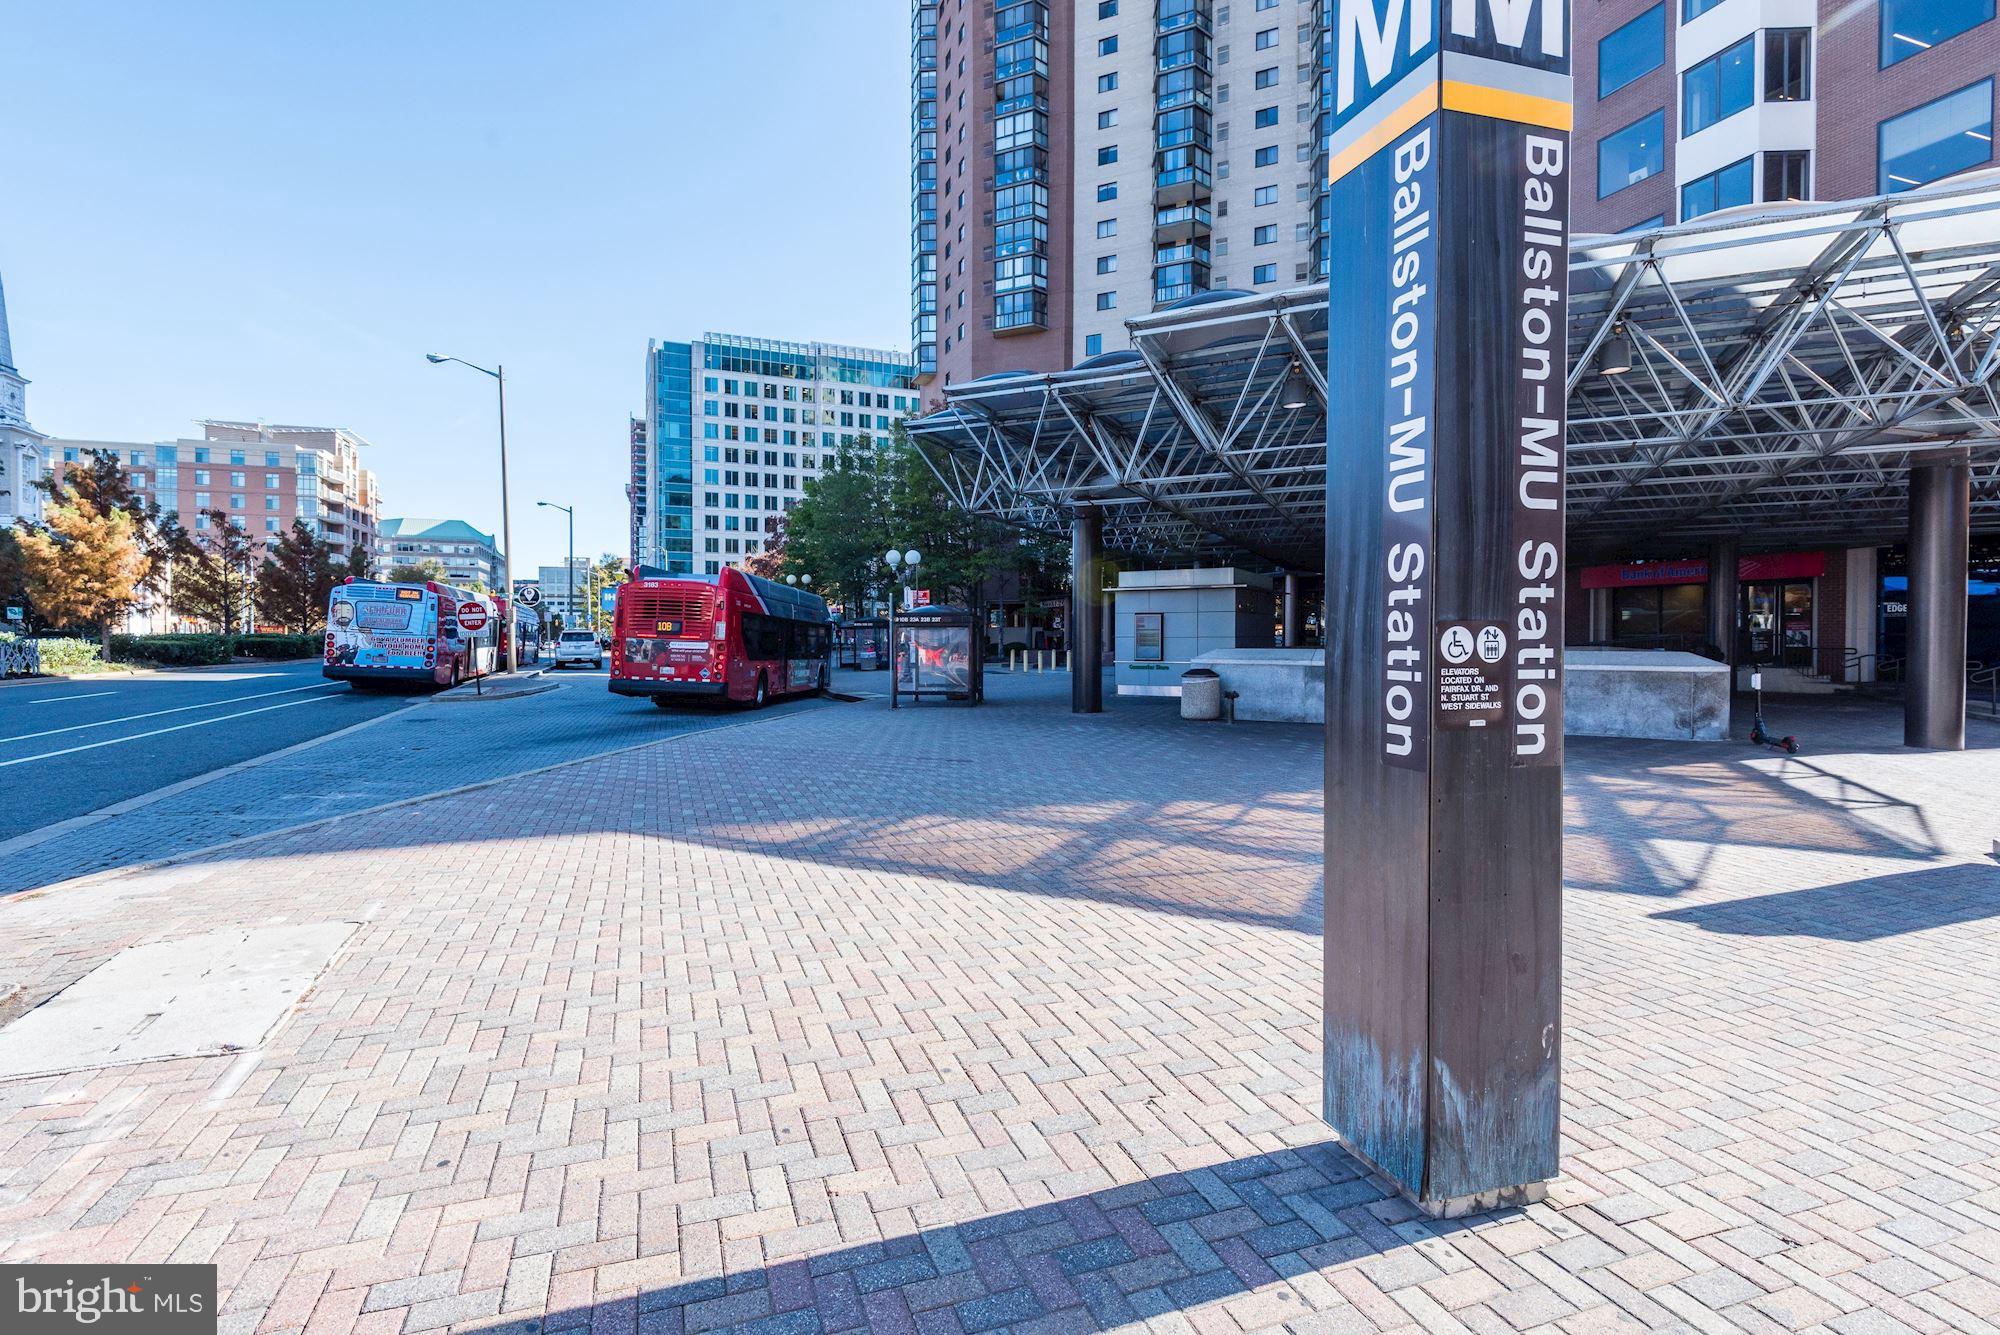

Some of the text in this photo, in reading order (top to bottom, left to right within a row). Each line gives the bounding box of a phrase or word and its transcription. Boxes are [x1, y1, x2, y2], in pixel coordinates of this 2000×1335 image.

[1620, 569, 1650, 580] Bank
[1886, 604, 1907, 613] EDGE
[657, 622, 672, 631] 10B
[1385, 542, 1425, 756] Station
[1516, 539, 1558, 755] Station
[1441, 668, 1479, 676] ELEVATORS
